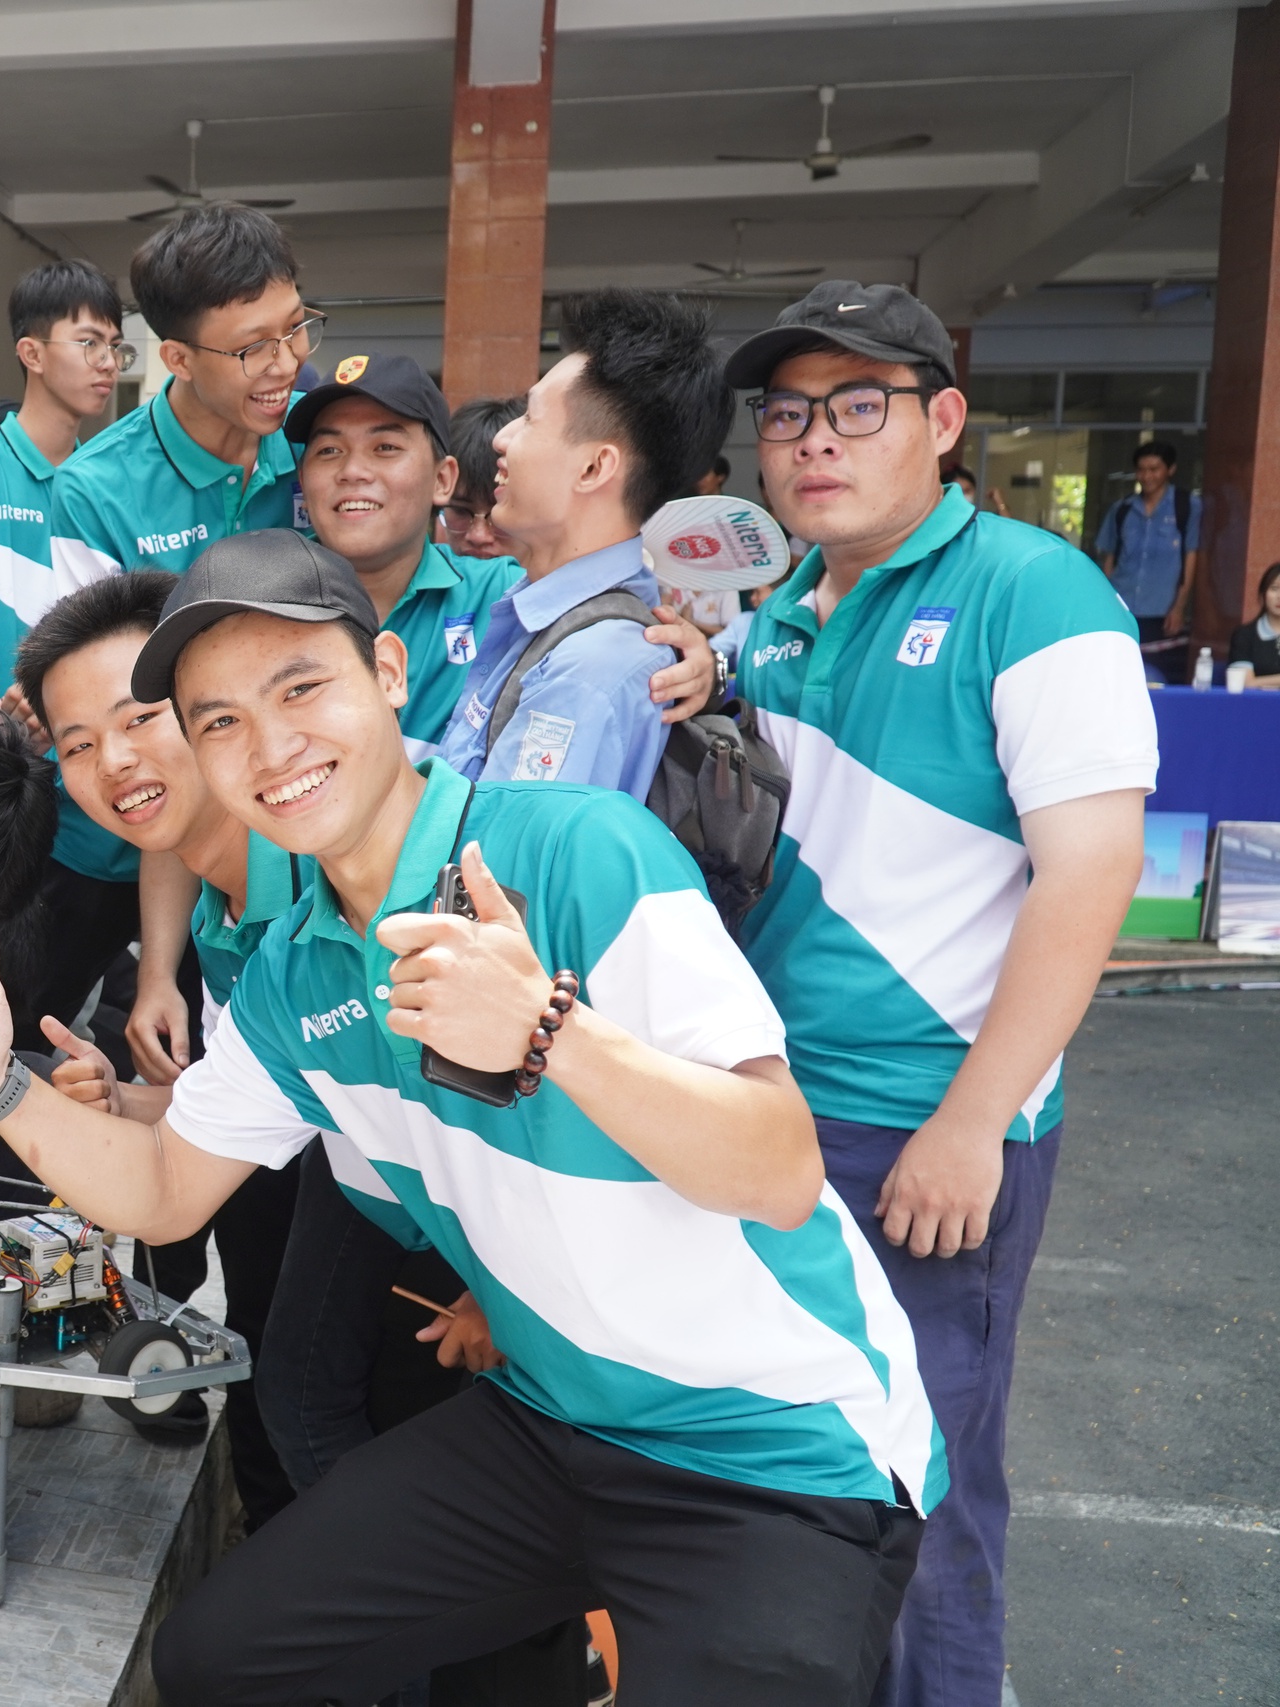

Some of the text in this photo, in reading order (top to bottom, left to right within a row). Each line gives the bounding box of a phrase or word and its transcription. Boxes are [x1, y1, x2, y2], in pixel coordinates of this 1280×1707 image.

[136, 524, 209, 555] Niterra
[693, 537, 714, 554] NGK
[727, 510, 773, 567] Niterra
